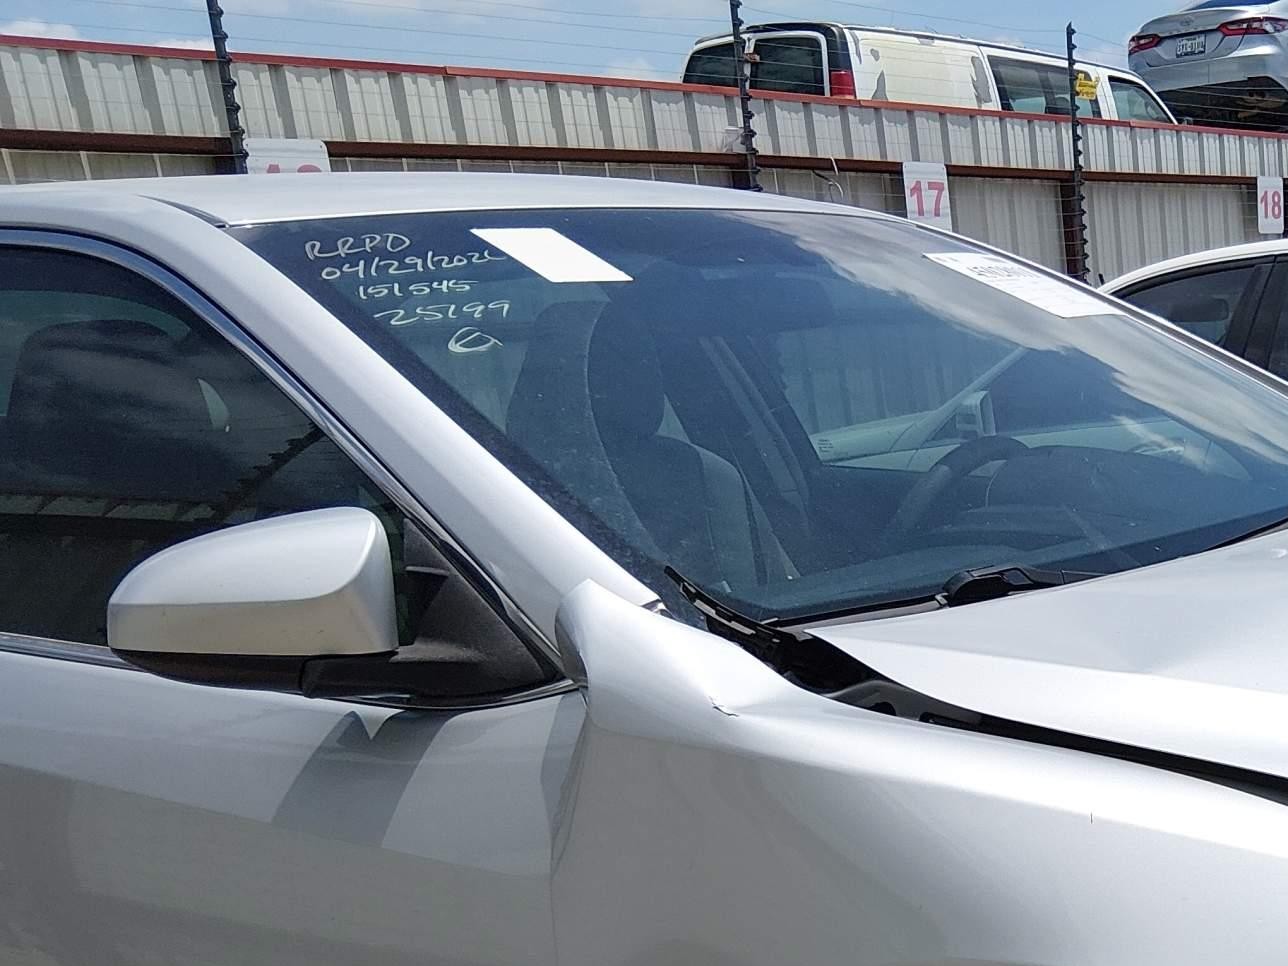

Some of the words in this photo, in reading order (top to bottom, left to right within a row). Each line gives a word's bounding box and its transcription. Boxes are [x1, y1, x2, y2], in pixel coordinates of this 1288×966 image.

[910, 180, 945, 217] 17
[1260, 190, 1281, 219] 18
[305, 233, 411, 260] RRPD
[357, 279, 479, 299] 151545
[373, 300, 511, 326] 25199
